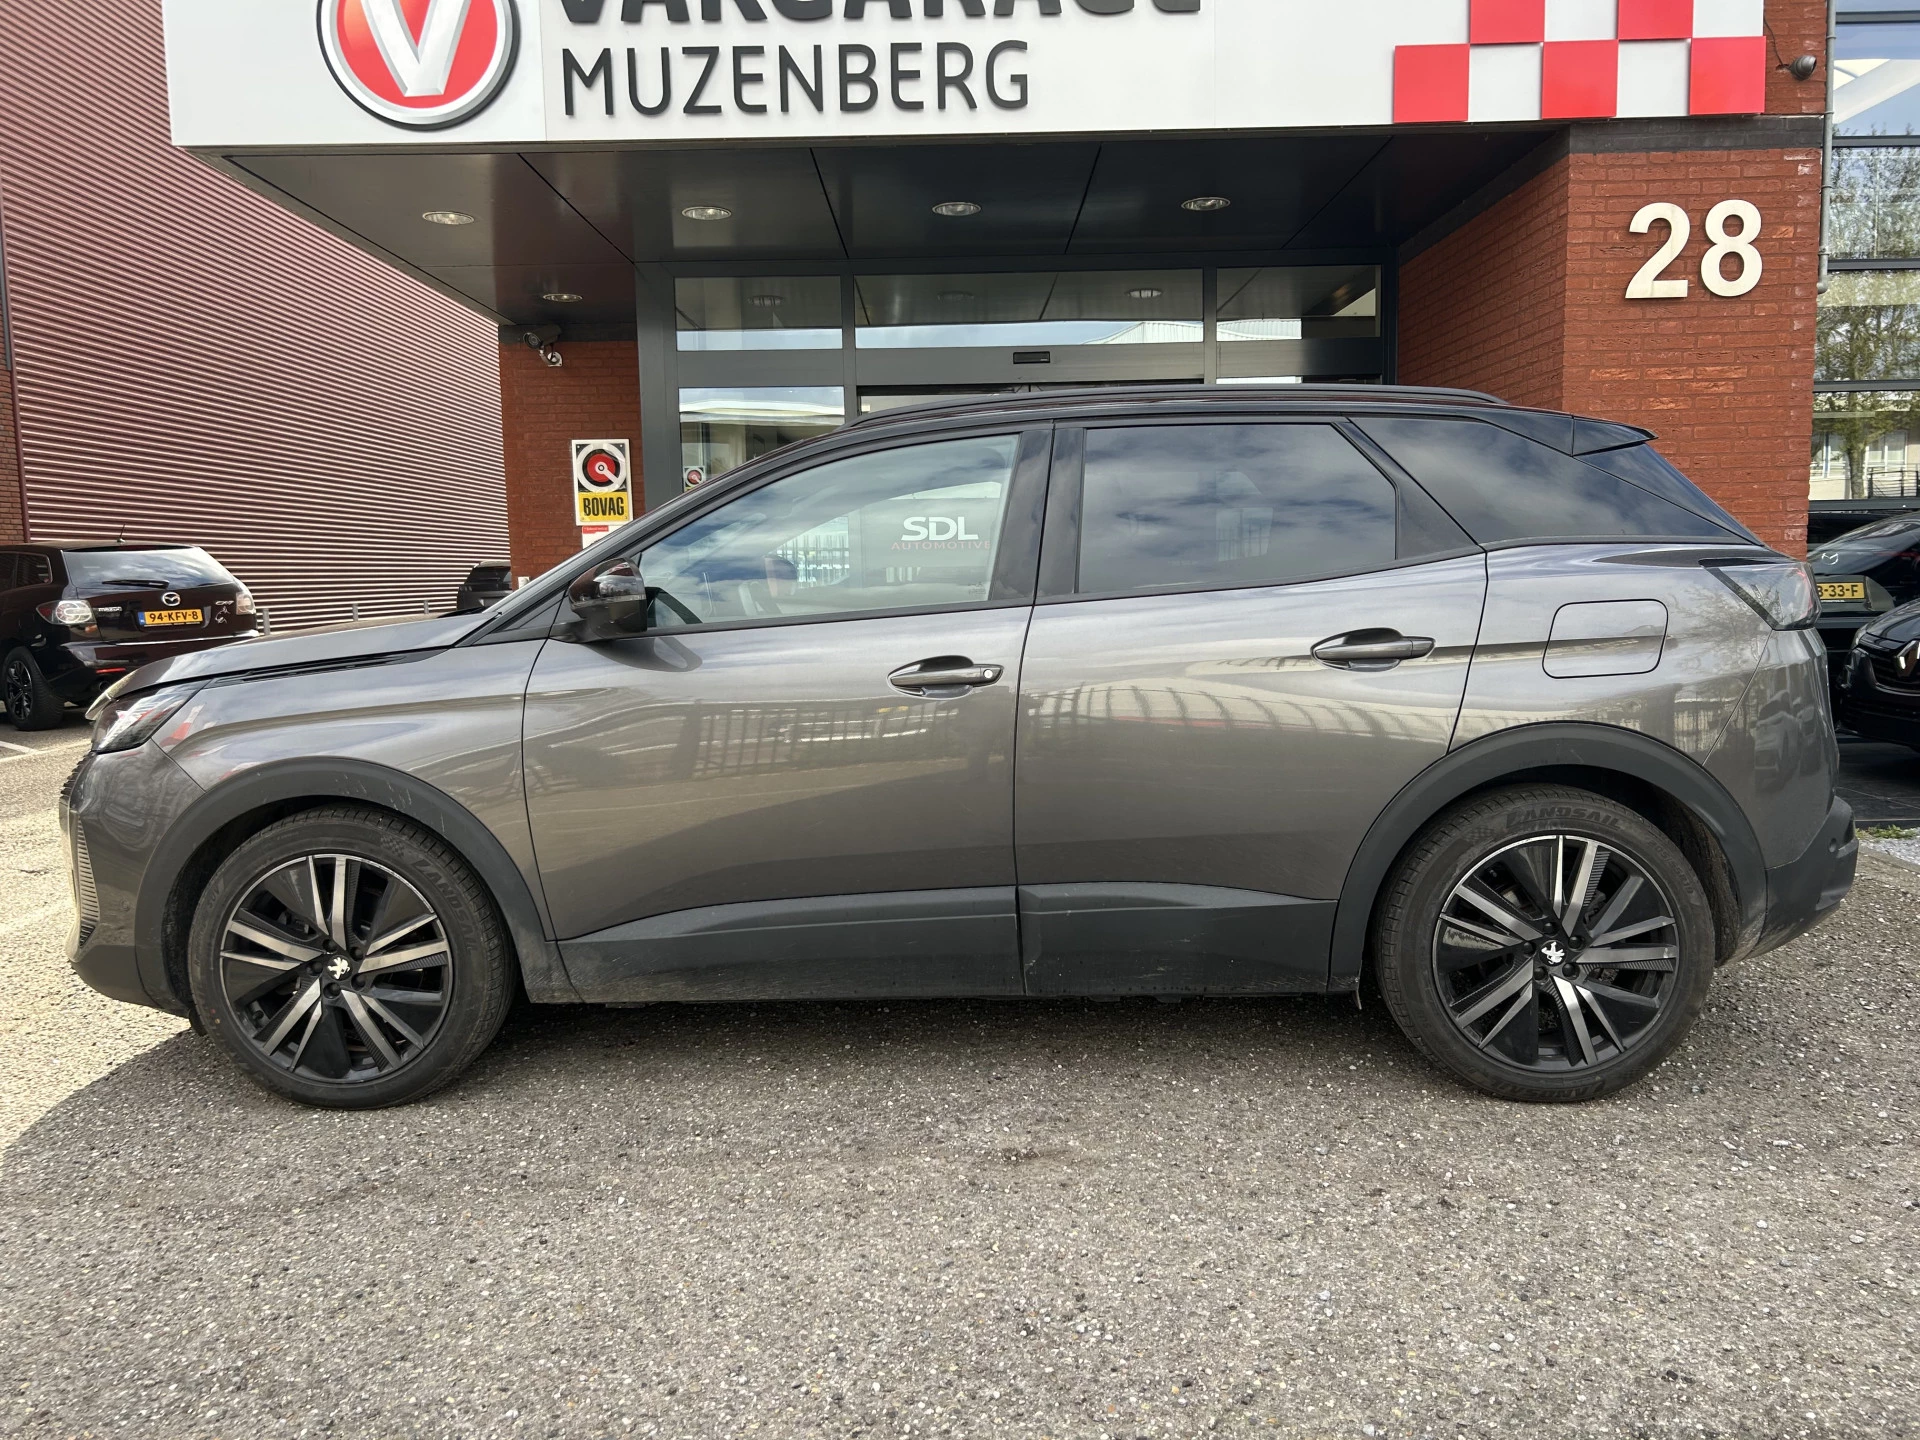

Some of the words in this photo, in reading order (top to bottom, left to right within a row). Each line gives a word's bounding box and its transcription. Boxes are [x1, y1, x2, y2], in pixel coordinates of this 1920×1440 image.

[562, 40, 1028, 116] MUZENBERG
[1625, 199, 1763, 298] 28
[583, 496, 625, 516] BOVAG
[901, 516, 979, 541] SDL
[891, 541, 991, 551] AUTOMOTIVE
[149, 610, 199, 622] 94-KFV-8
